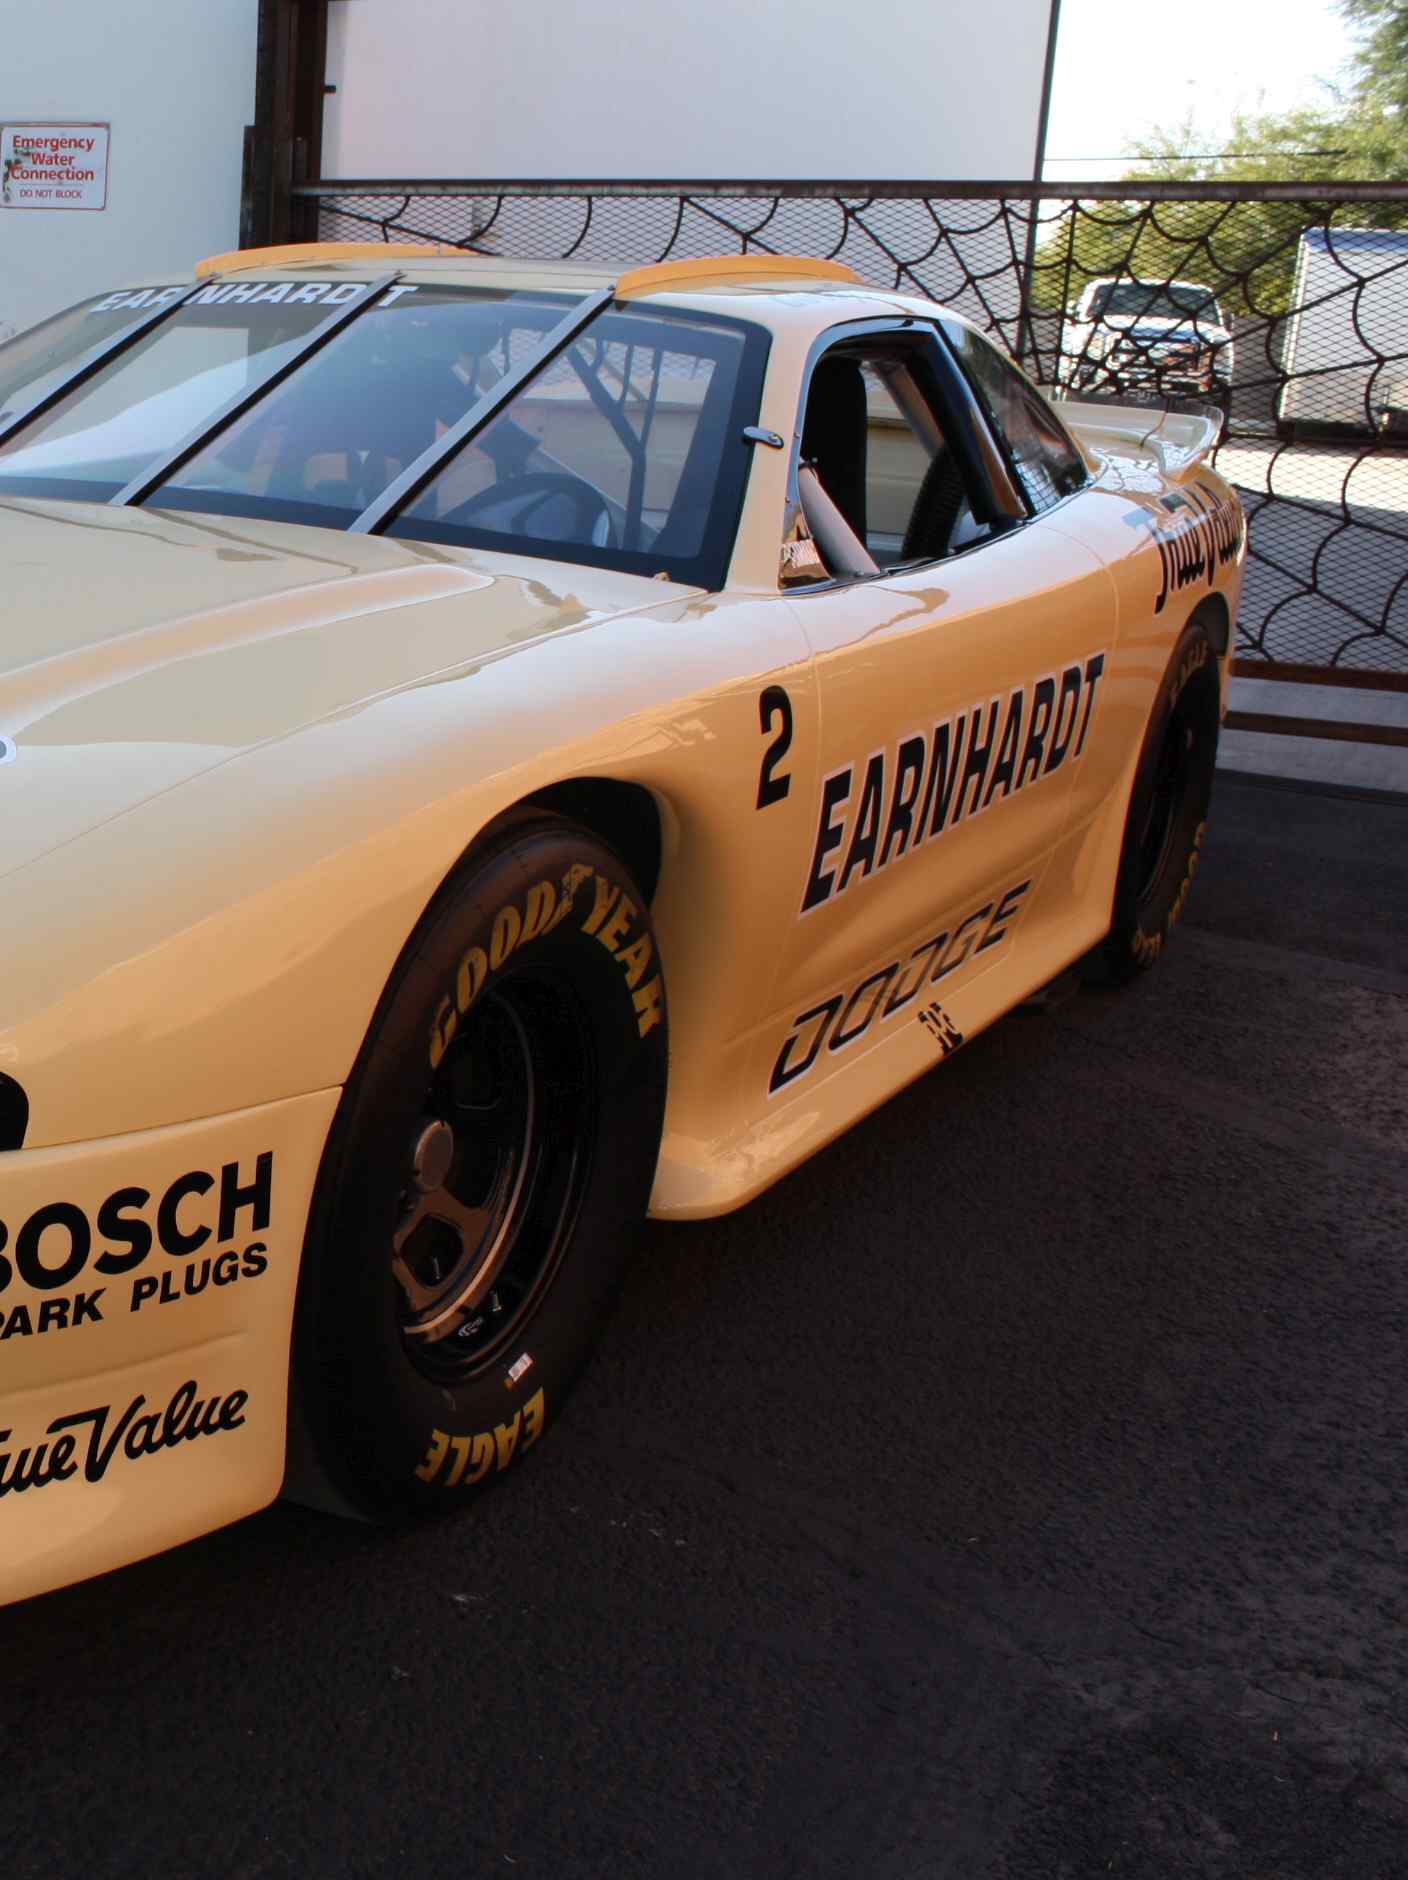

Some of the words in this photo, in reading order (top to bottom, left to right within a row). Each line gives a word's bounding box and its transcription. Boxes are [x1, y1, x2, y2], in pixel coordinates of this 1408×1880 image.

[11, 167, 95, 181] Connection
[12, 134, 96, 152] Emergency
[31, 152, 76, 166] Water
[19, 189, 33, 198] DO
[35, 189, 52, 199] NOT
[55, 189, 82, 199] BLOCK
[755, 684, 793, 811] 2
[799, 651, 1105, 917] EARNHARDT
[767, 879, 1032, 1099] DODGE
[130, 1241, 269, 1313] PLUGS
[414, 1385, 545, 1487] EAGLE
